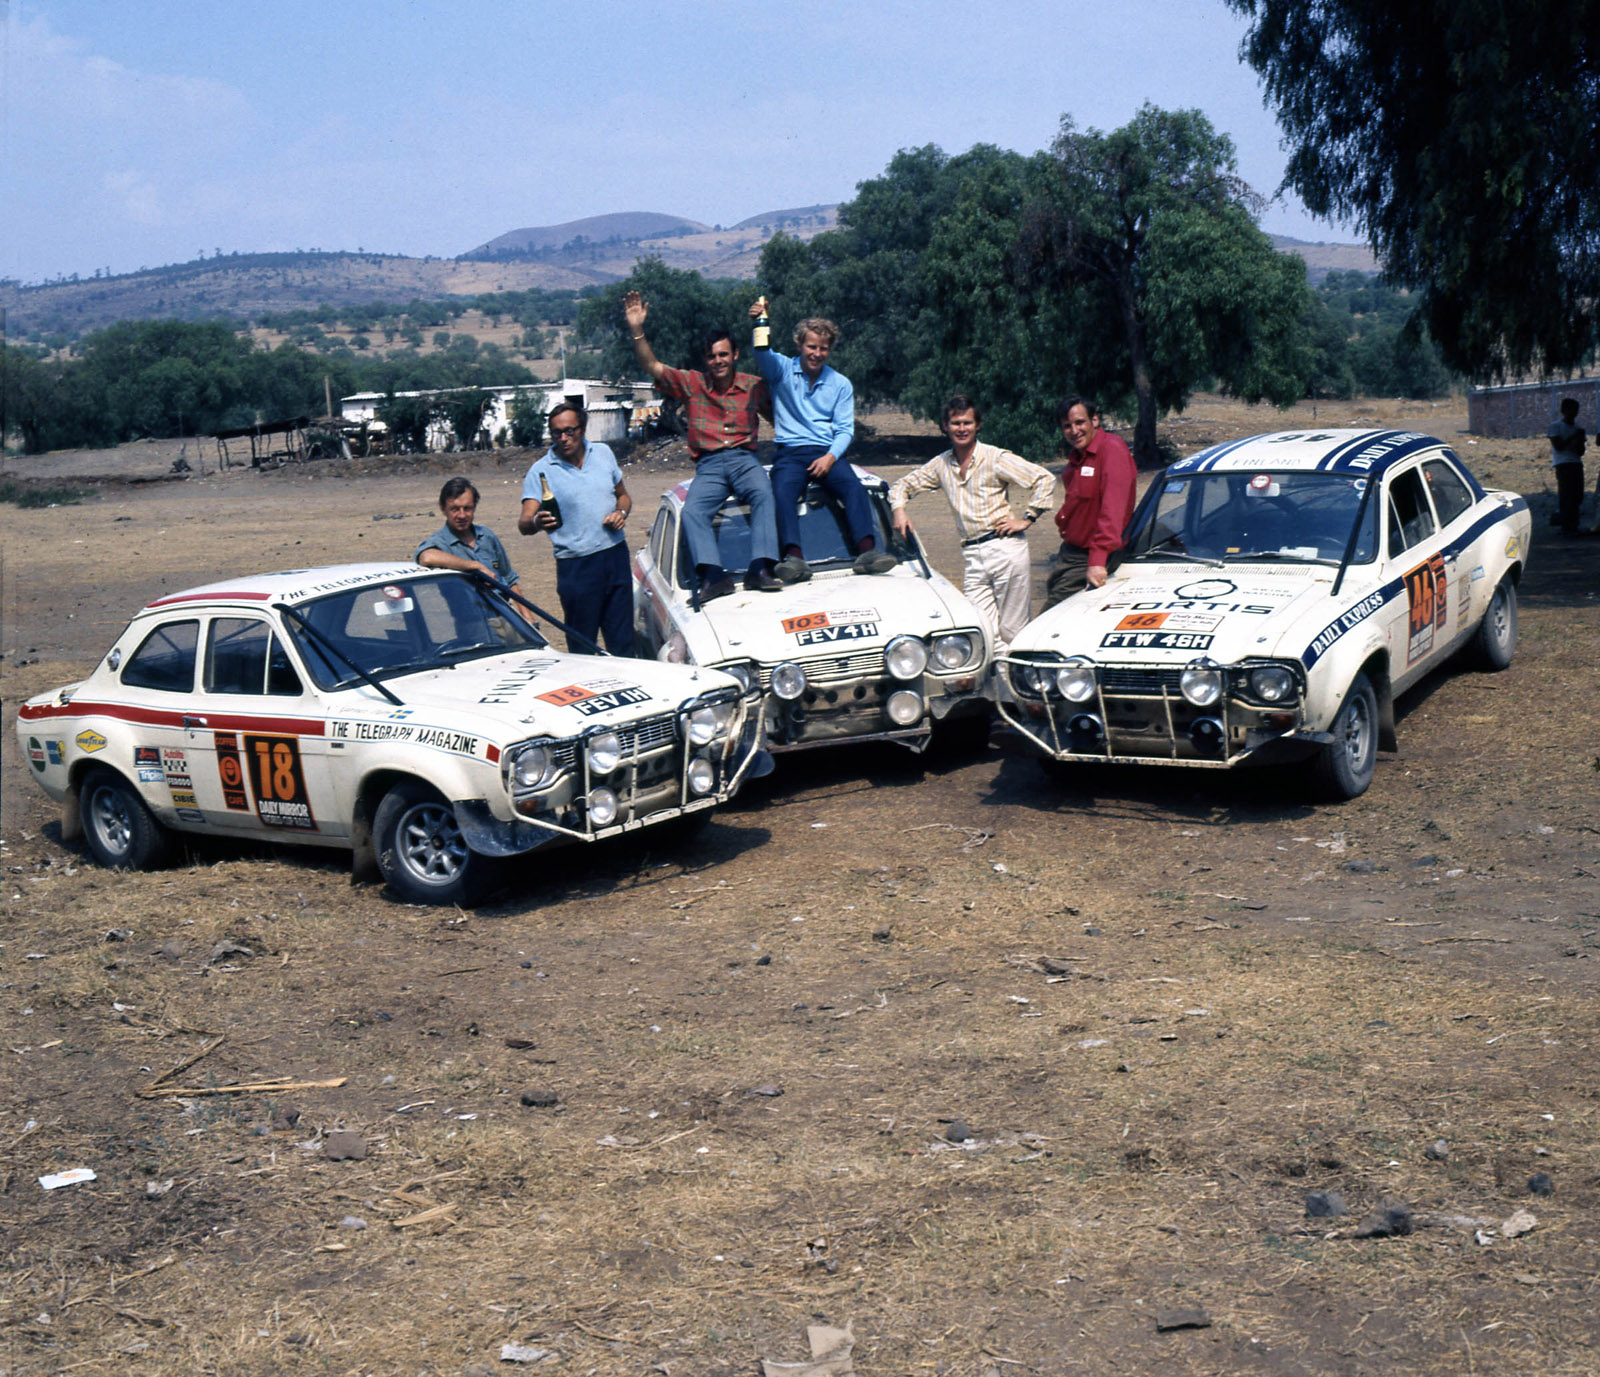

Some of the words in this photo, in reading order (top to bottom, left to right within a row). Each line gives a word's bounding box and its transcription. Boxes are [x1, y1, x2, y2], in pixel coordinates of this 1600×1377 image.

[1348, 443, 1394, 470] DAILY
[279, 589, 308, 601] THE
[312, 569, 394, 592] TELEGRAPH
[1100, 601, 1275, 615] FORTIS
[1411, 569, 1434, 631] 46
[787, 614, 826, 630] 103
[797, 626, 840, 645] FEV
[844, 622, 877, 638] 4H
[1126, 614, 1159, 628] 46
[1311, 620, 1343, 657] DAILY
[1340, 591, 1384, 629] EXPRESS
[1103, 633, 1157, 647] FTW
[1159, 635, 1211, 649] 46H
[478, 658, 561, 704] FINLAND
[550, 688, 584, 702] 18
[573, 694, 620, 715] FEV
[620, 688, 650, 703] 1H
[332, 721, 349, 738] THE
[355, 723, 414, 740] TELEGRAPH
[415, 728, 478, 755] MAGAZINE
[255, 741, 296, 801] 18
[258, 800, 278, 815] DAILY
[279, 801, 309, 817] MIRROR
